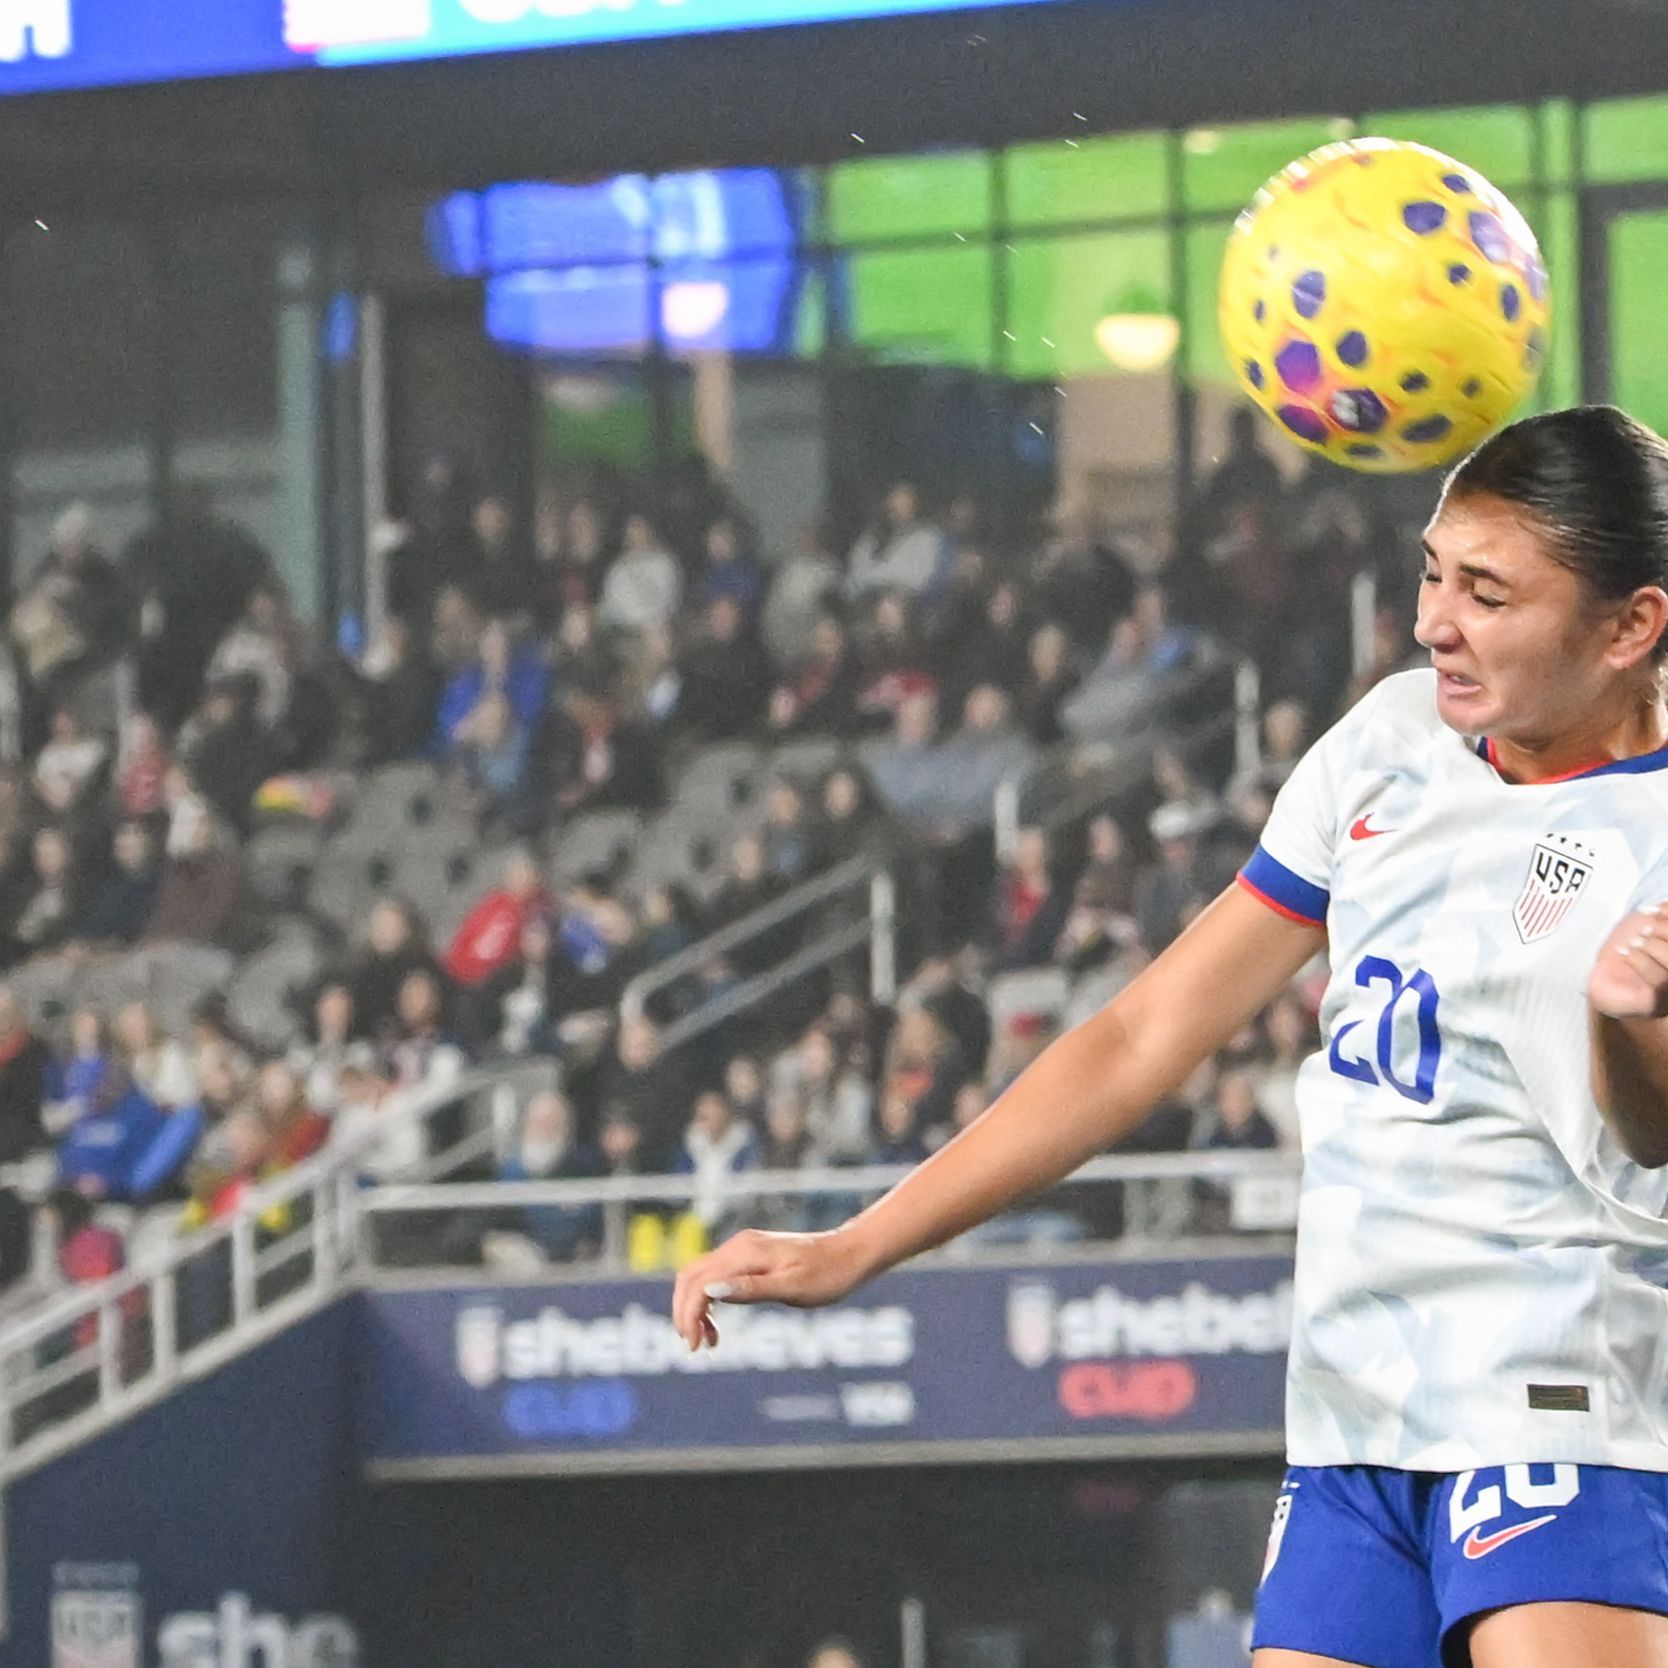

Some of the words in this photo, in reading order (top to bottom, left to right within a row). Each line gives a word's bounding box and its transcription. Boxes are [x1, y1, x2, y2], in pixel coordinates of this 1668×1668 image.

[1535, 850, 1586, 895] USA
[1329, 954, 1442, 1106] 20
[1449, 1463, 1580, 1543] 20
